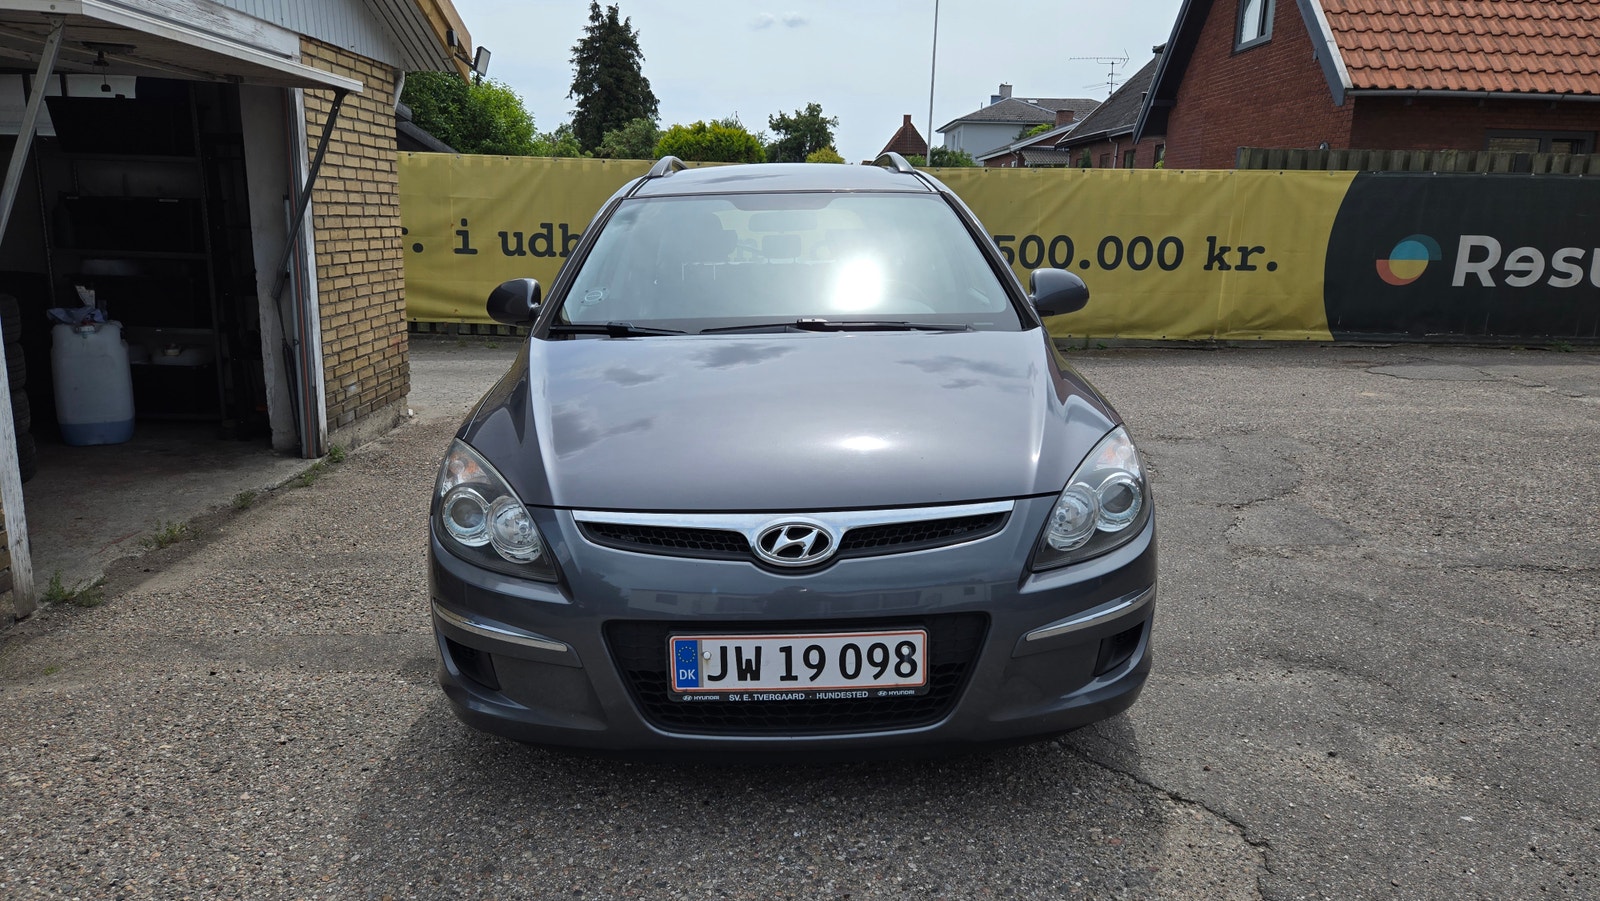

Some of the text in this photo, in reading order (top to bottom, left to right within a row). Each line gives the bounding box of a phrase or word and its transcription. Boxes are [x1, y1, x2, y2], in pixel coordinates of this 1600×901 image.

[453, 218, 478, 255] i
[992, 234, 1279, 273] 500.000 kr.
[679, 640, 918, 682] DK JW 19 098
[728, 694, 742, 702] SV.
[753, 693, 806, 702] TVERGAARD
[816, 691, 869, 700] HUNDESTED
